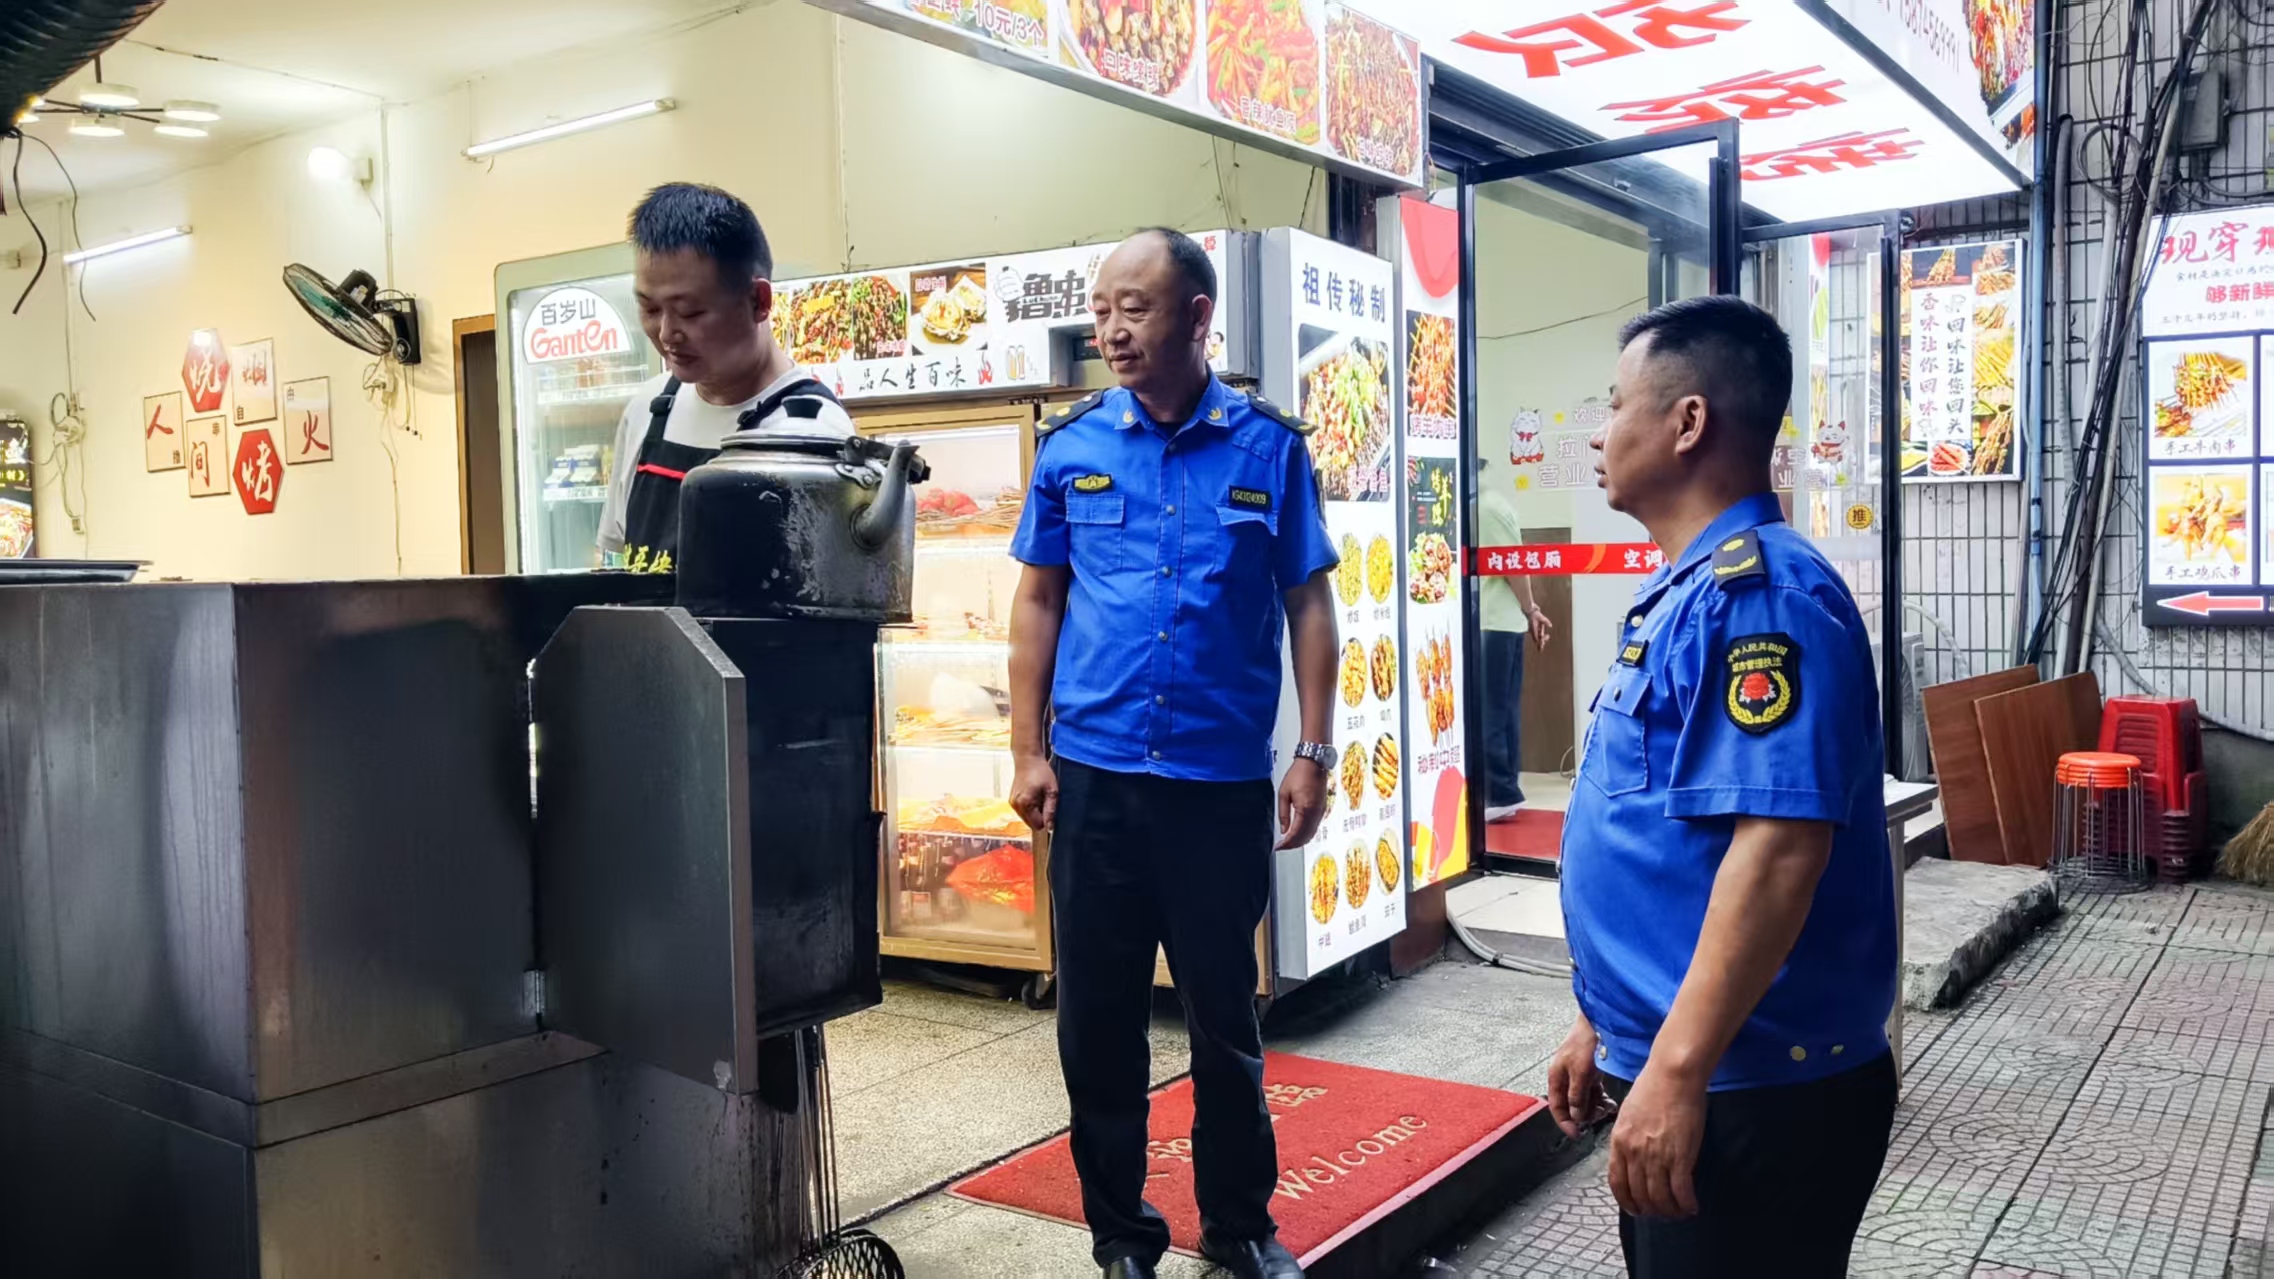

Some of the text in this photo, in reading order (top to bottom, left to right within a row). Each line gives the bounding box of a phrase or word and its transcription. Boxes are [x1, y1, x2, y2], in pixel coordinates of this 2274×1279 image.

[1302, 262, 1386, 324] 祖传秘制
[541, 298, 597, 327] 百岁山
[1919, 292, 1939, 417] 香味让你回味
[859, 357, 966, 392] 品人生百味
[1945, 316, 1967, 435] 回味让您回头
[147, 404, 174, 440] 人
[301, 409, 331, 455] 火
[189, 441, 211, 488] 间
[2165, 438, 2236, 456] 手工牛肉串
[241, 440, 274, 503] 烤
[1537, 463, 1603, 488] 营业
[1853, 508, 1866, 523] 推
[1488, 550, 1562, 570] 内设包厢
[1624, 548, 1669, 569] 空调
[1274, 1114, 1427, 1200] Welcome
